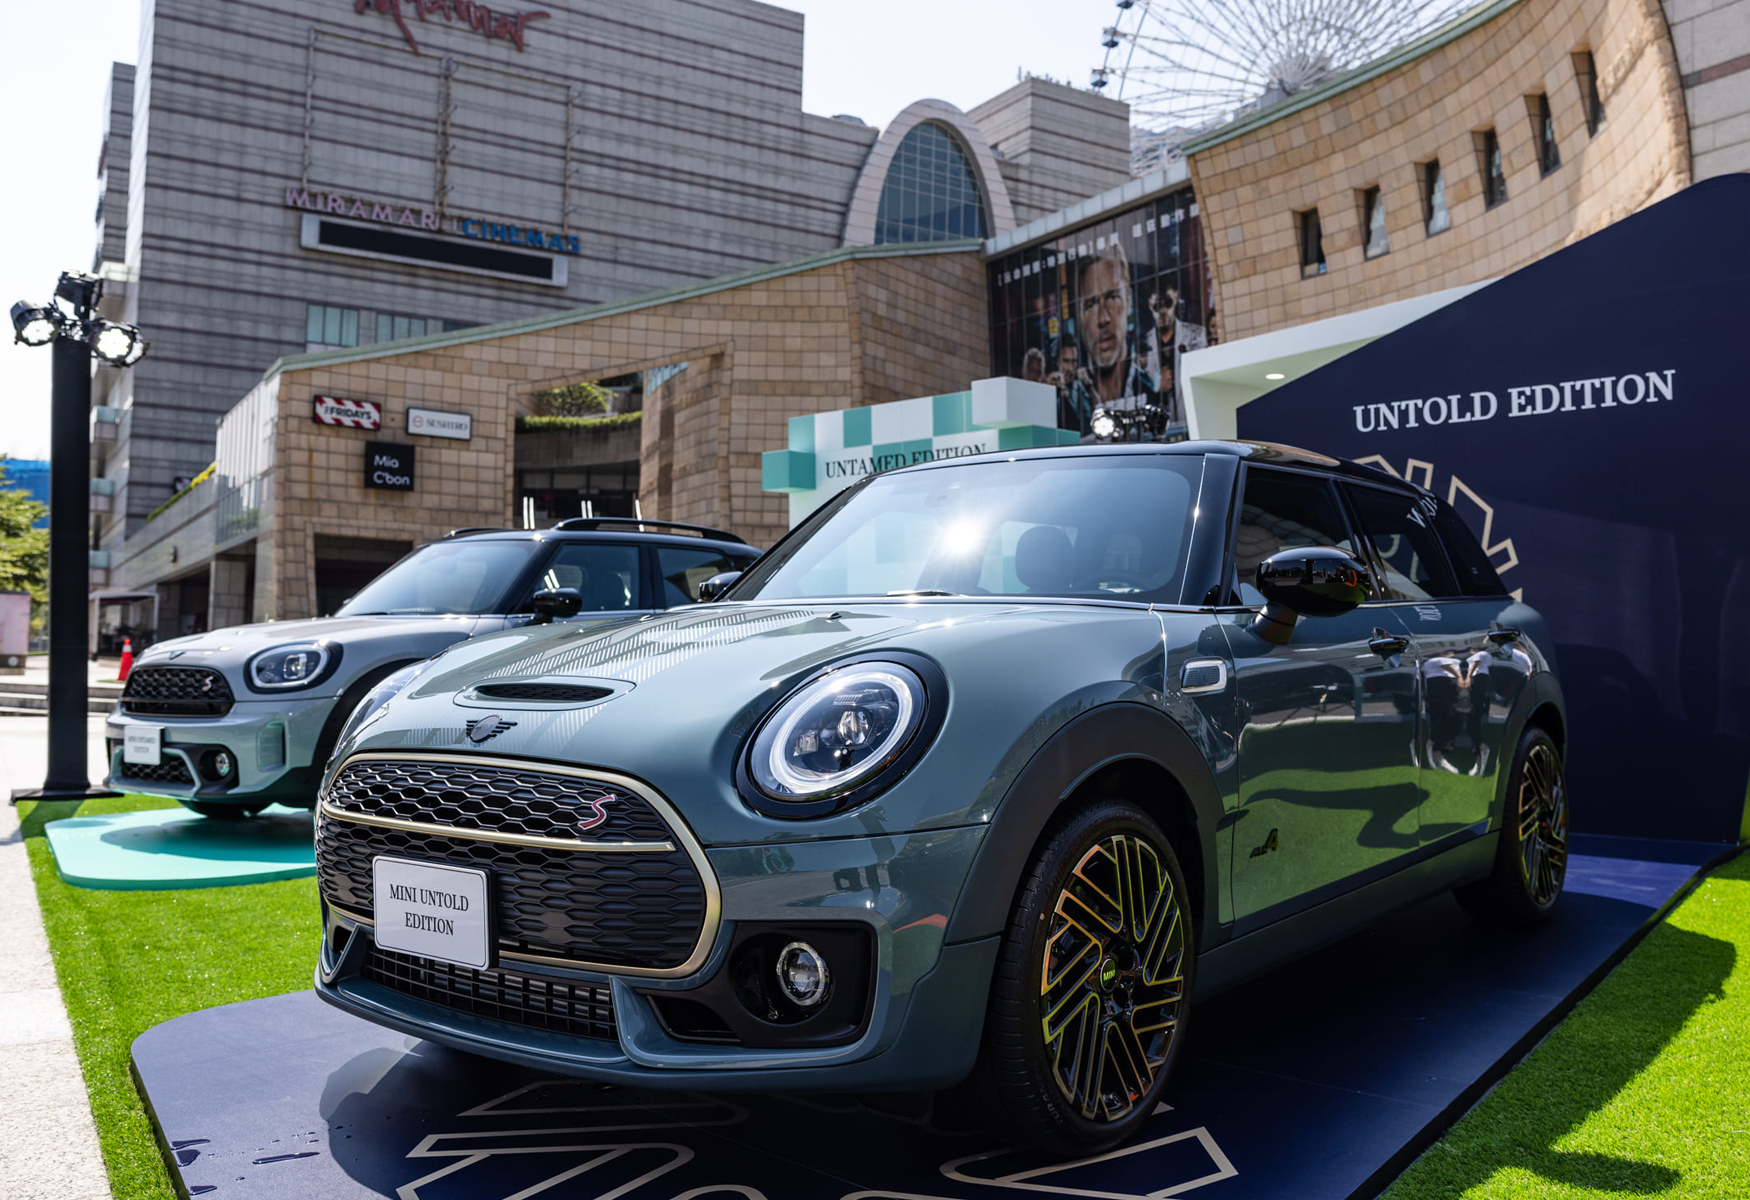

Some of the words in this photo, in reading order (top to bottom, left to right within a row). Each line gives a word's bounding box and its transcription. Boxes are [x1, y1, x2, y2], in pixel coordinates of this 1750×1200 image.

[286, 188, 439, 231] MIRAMAR
[463, 218, 580, 254] CINEMAS
[1353, 391, 1499, 433] UNTOLD
[1507, 369, 1676, 417] EDITION
[373, 455, 400, 469] Mia
[825, 453, 906, 478] UNTAMED
[911, 443, 987, 465] EDITION
[373, 471, 410, 485] C'bon
[577, 794, 617, 831] S
[389, 883, 418, 904] MINI
[421, 889, 470, 912] UNTOLD
[404, 913, 455, 936] EDITION
